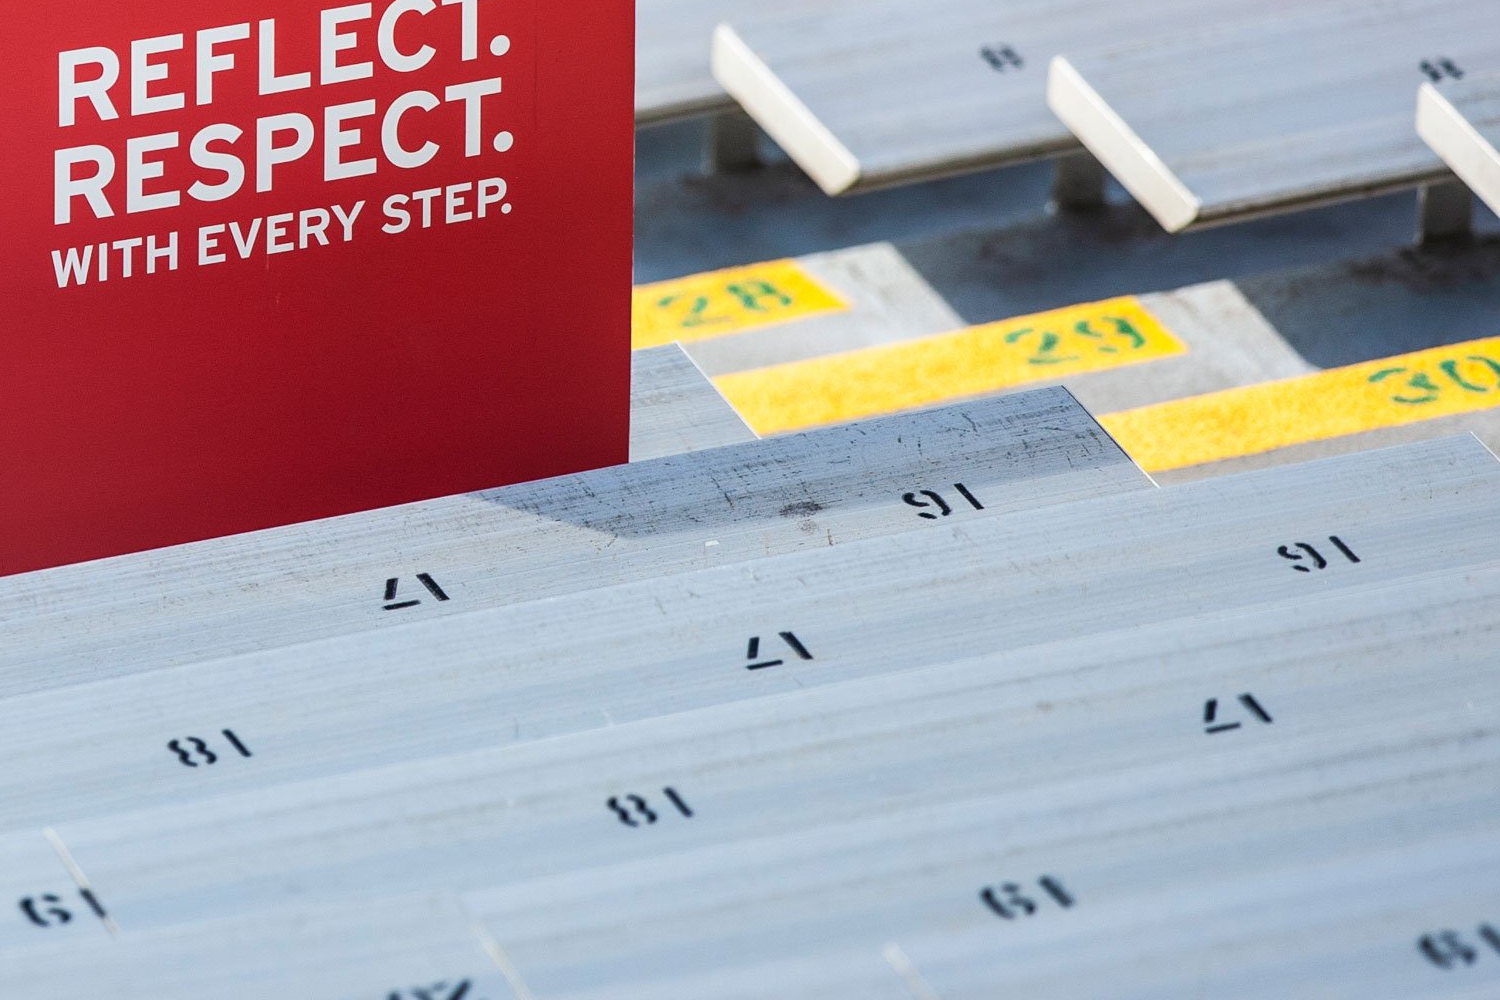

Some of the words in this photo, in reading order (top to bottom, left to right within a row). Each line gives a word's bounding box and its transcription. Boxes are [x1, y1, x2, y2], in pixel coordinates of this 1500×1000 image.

[53, 77, 514, 225] RESPECT.
[51, 231, 179, 288] WITH
[198, 200, 366, 266] EVERY
[381, 177, 513, 235] STEP.
[658, 278, 792, 328] 28
[1005, 316, 1146, 365] 29
[1367, 356, 1500, 405] 30
[901, 482, 985, 520] 16
[1277, 535, 1361, 573] 16
[167, 728, 253, 768] 18
[605, 786, 694, 829] 18
